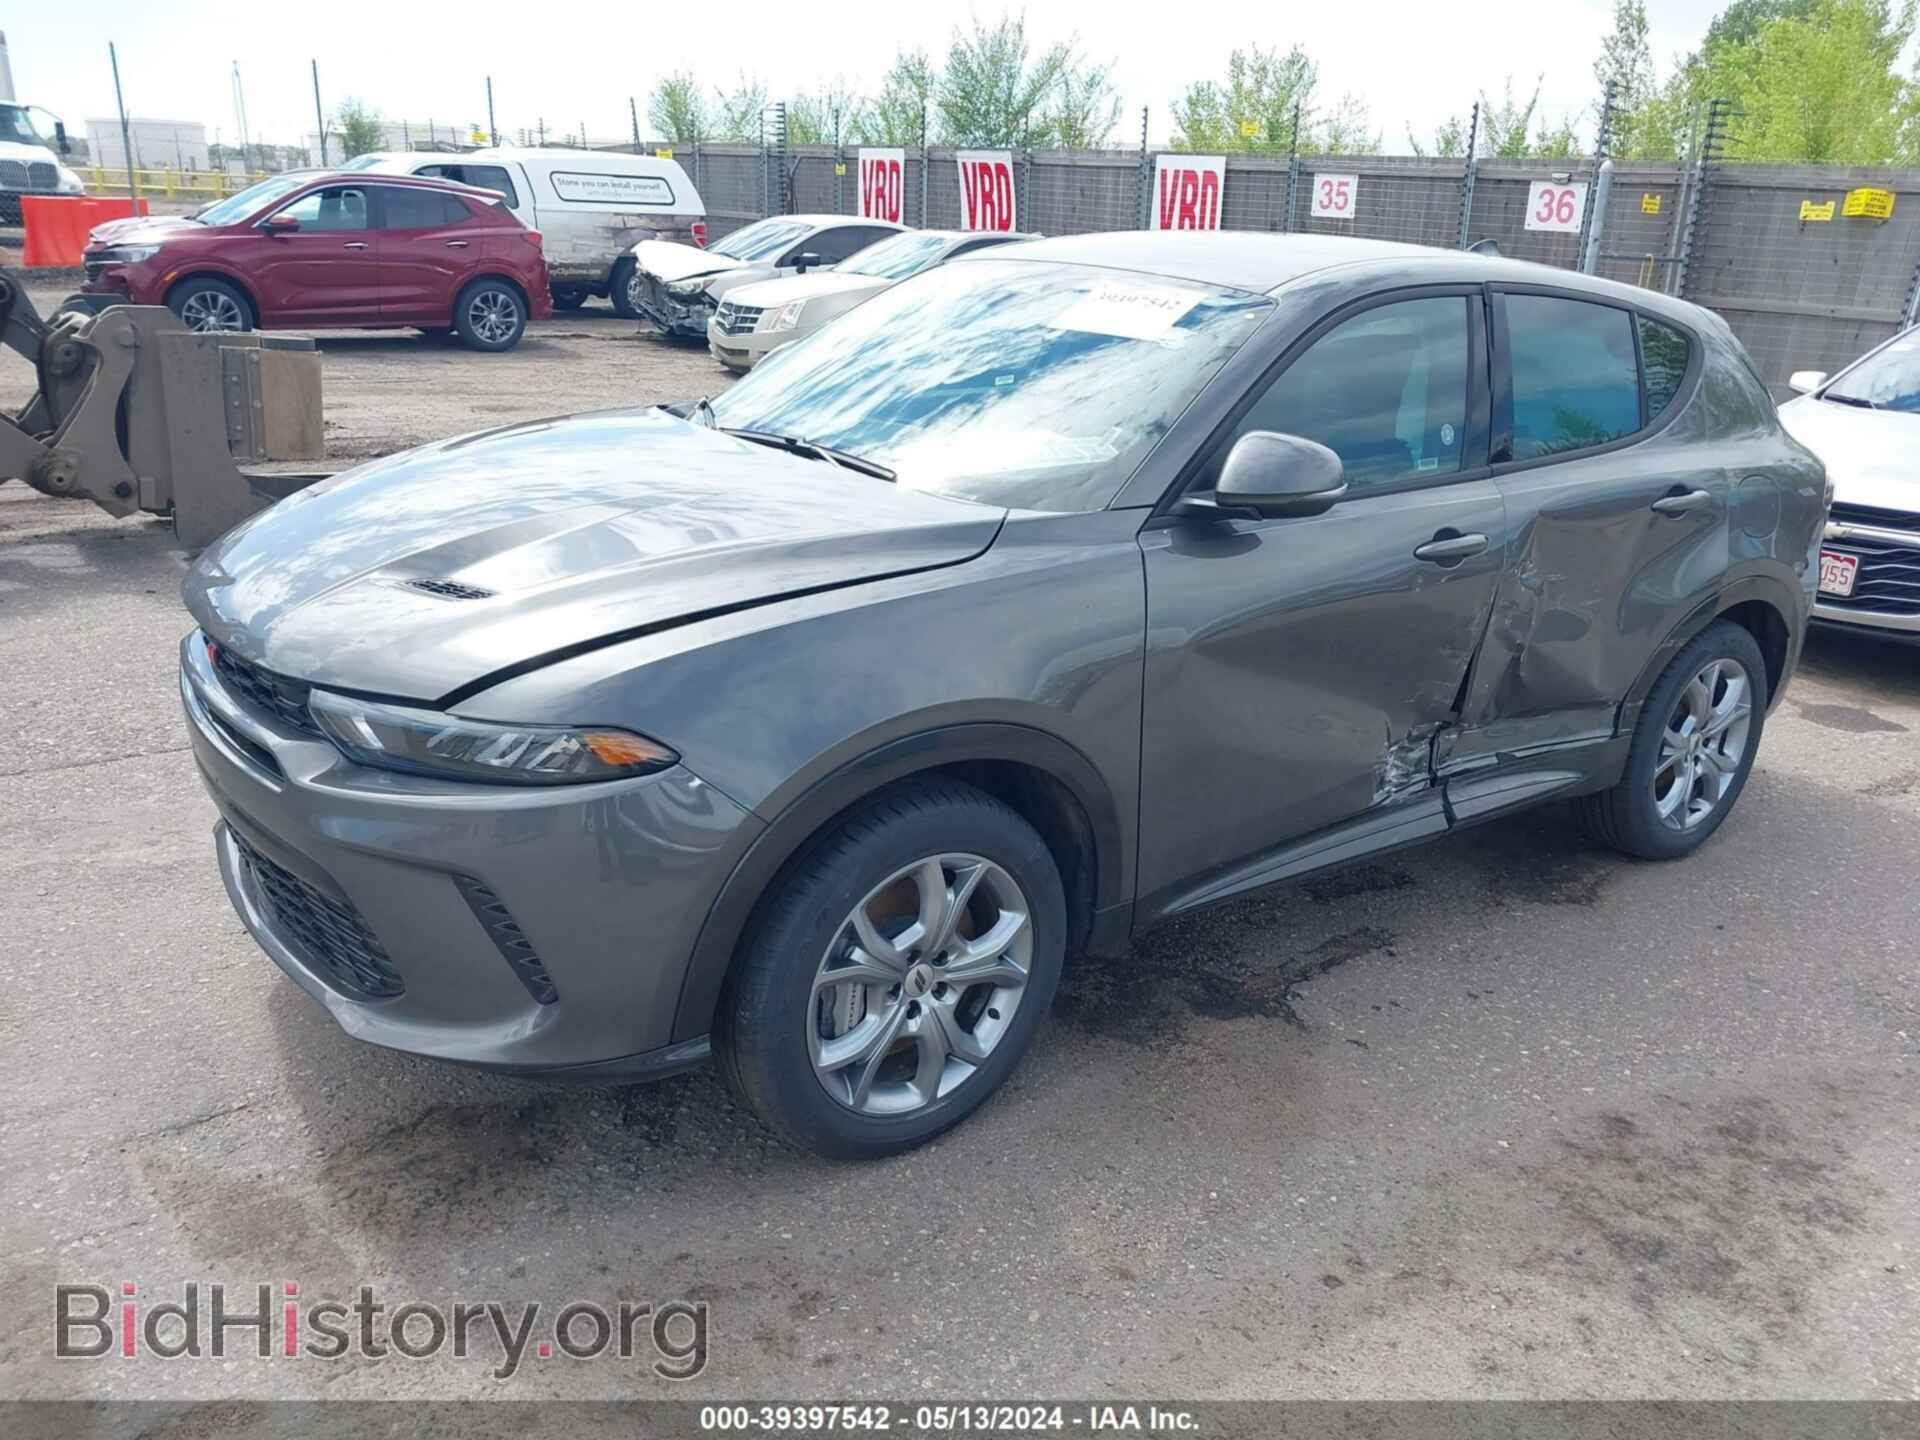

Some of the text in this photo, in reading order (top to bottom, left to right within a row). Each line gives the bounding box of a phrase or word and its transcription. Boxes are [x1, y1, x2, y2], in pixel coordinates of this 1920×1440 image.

[862, 159, 901, 223] VRD
[961, 161, 1012, 232] VRD
[1159, 168, 1219, 231] VRD
[1318, 180, 1350, 211] 35
[1535, 188, 1576, 225] 36
